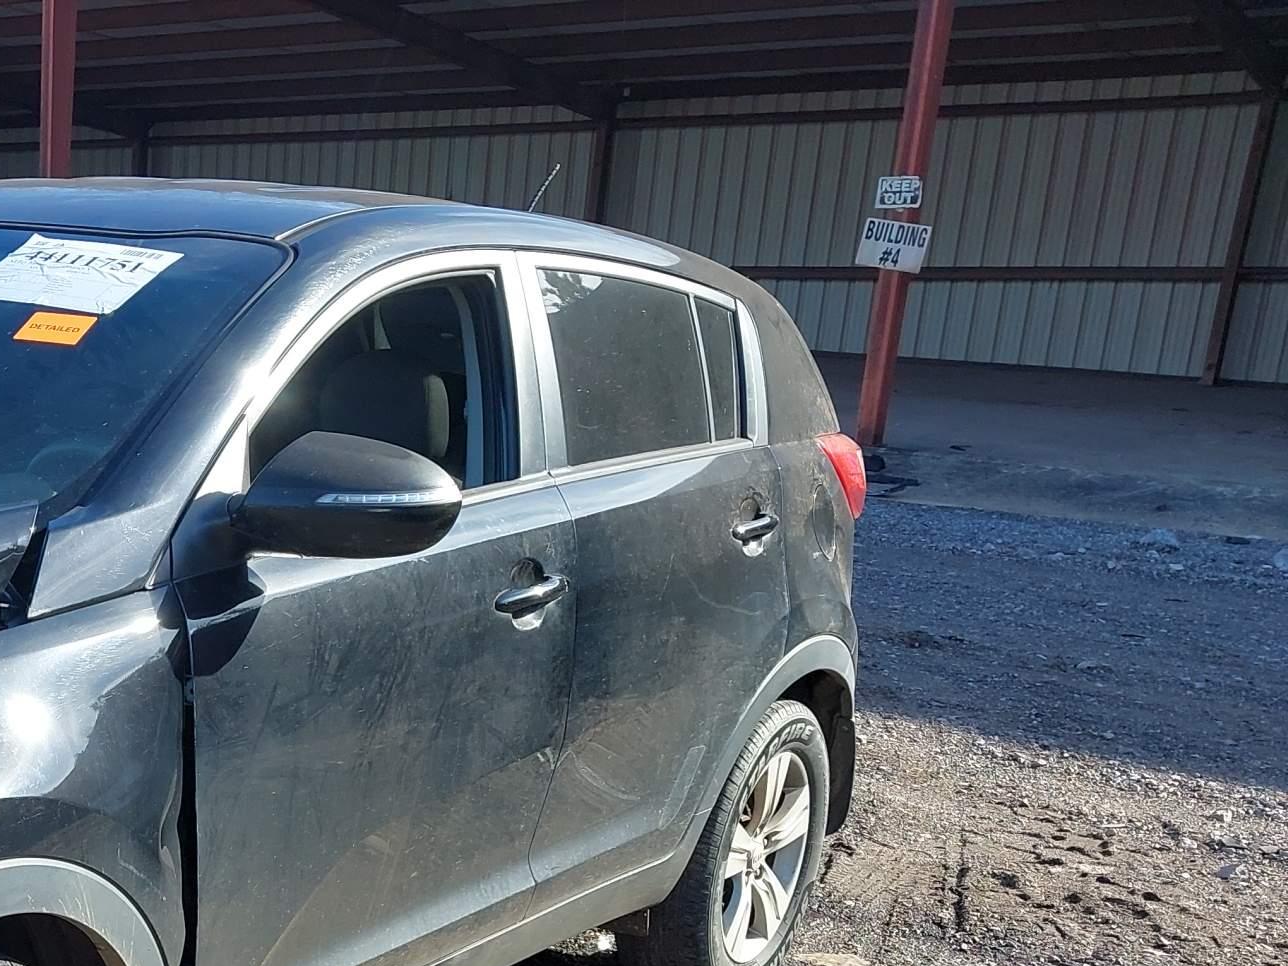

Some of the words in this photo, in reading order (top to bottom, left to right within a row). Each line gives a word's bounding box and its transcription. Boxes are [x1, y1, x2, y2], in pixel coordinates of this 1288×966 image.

[881, 180, 920, 192] KEEP
[883, 192, 914, 204] OUT
[865, 220, 928, 248] BUILDING
[24, 249, 144, 273] 44111751
[878, 247, 901, 267] #4
[29, 322, 81, 334] DETAILED
